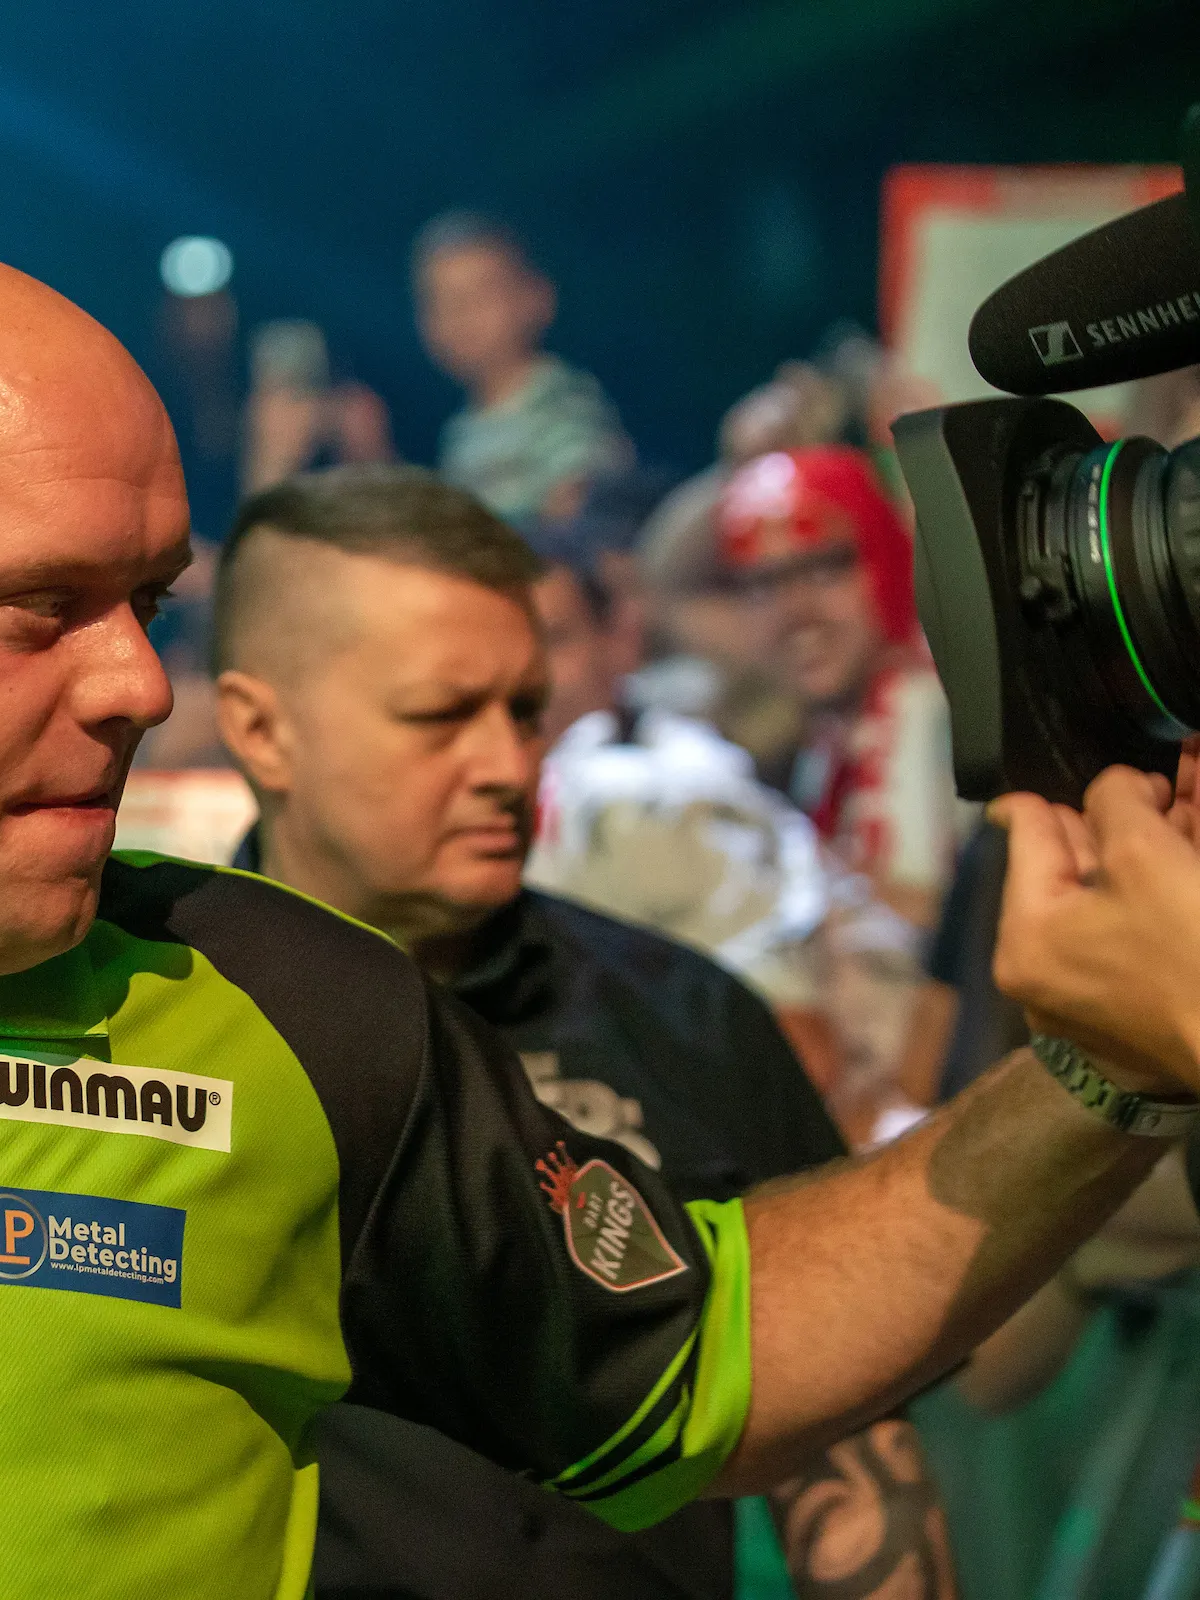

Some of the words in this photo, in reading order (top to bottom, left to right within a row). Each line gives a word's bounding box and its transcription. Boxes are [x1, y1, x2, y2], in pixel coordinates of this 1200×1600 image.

[48, 1215, 125, 1246] Metal
[590, 1181, 636, 1280] KINGS
[49, 1237, 177, 1283] Detecting
[50, 1262, 164, 1284] www.lpmetaldetecting.com
